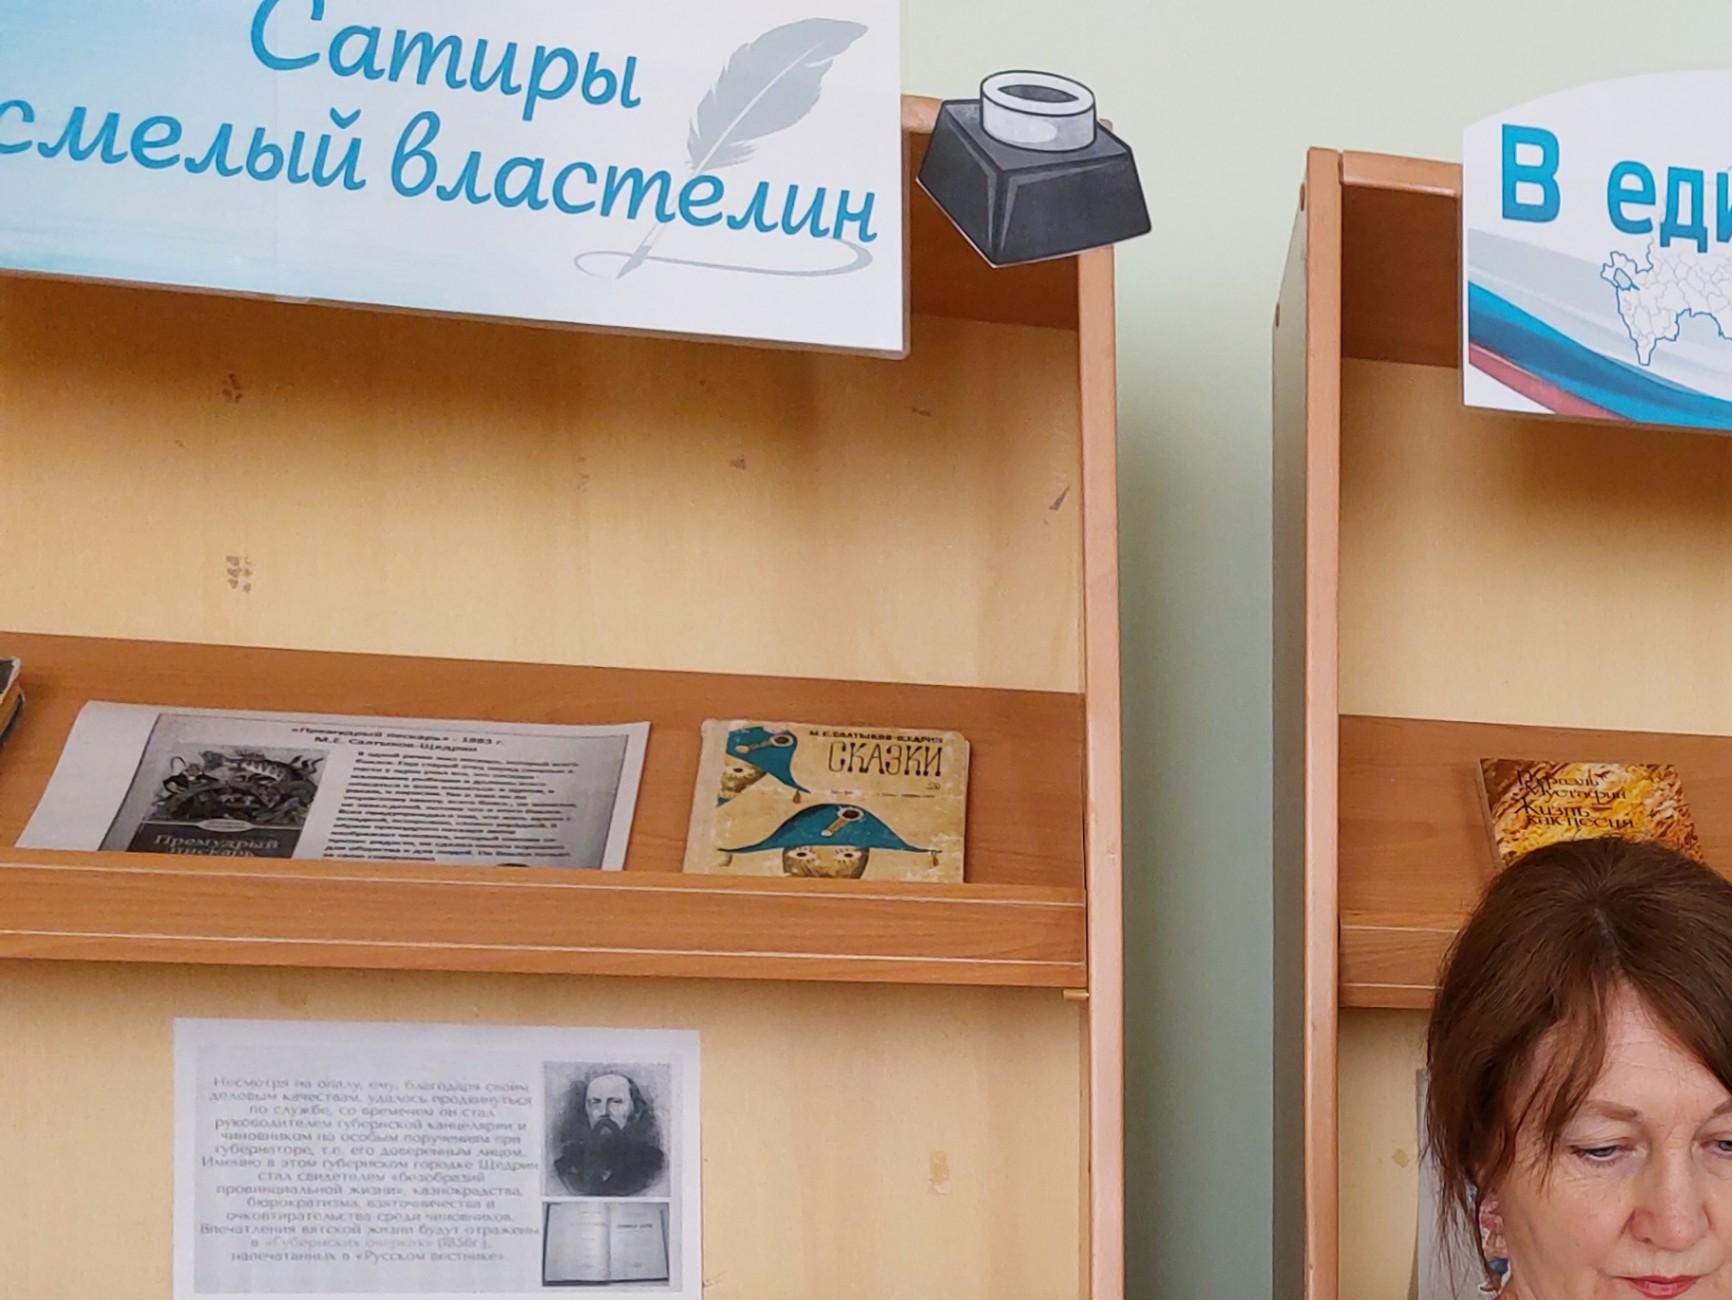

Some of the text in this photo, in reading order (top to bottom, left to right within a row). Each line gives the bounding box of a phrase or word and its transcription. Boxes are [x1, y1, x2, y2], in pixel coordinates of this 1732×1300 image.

[251, 0, 642, 121] Сатиры
[0, 95, 879, 242] смелый властелин
[1501, 124, 1562, 226] В
[828, 741, 943, 777] СКАЗКИ
[153, 834, 279, 849] Премудрый
[215, 1118, 332, 1130] руководителем
